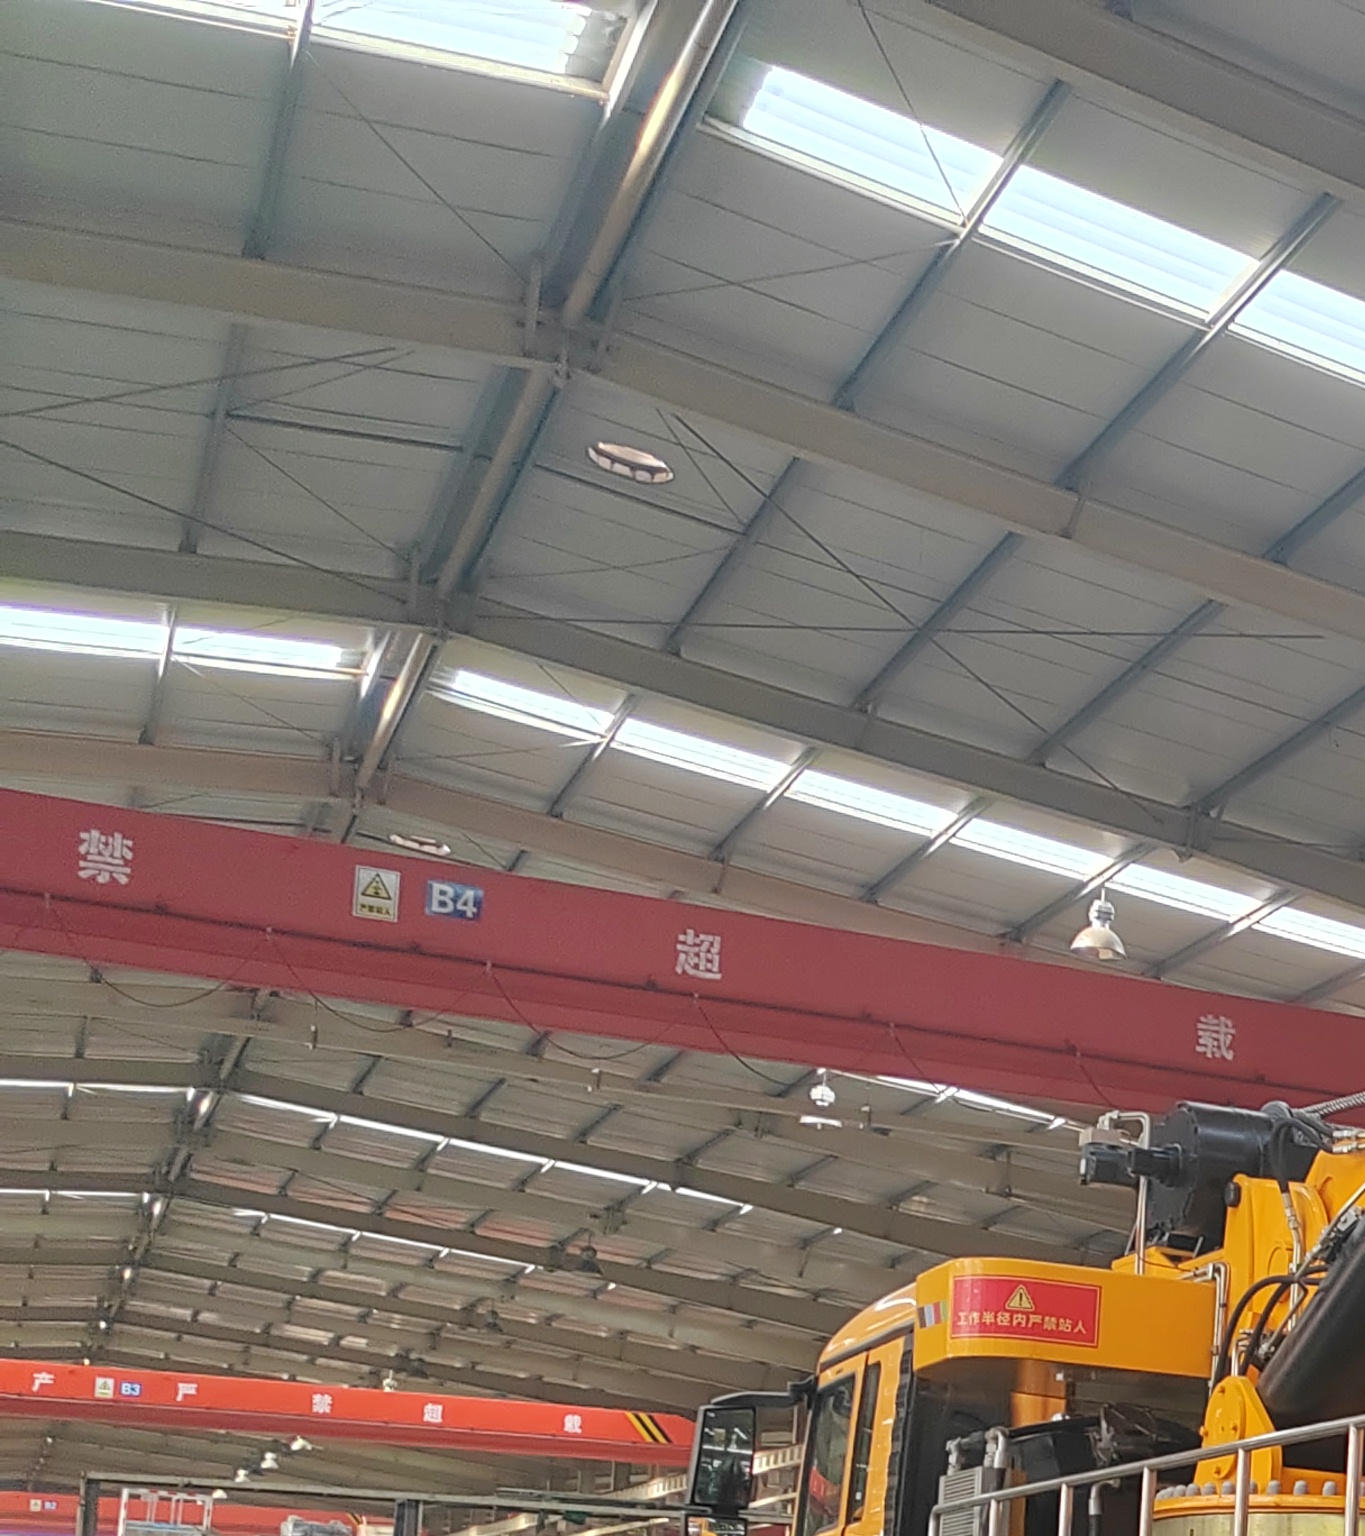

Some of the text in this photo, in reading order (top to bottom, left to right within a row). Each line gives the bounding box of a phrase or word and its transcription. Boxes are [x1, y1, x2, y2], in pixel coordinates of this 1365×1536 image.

[77, 829, 133, 885] 禁
[675, 928, 722, 980] 超
[431, 883, 478, 918] B4
[957, 1311, 1087, 1335] 工作半径内严禁站人
